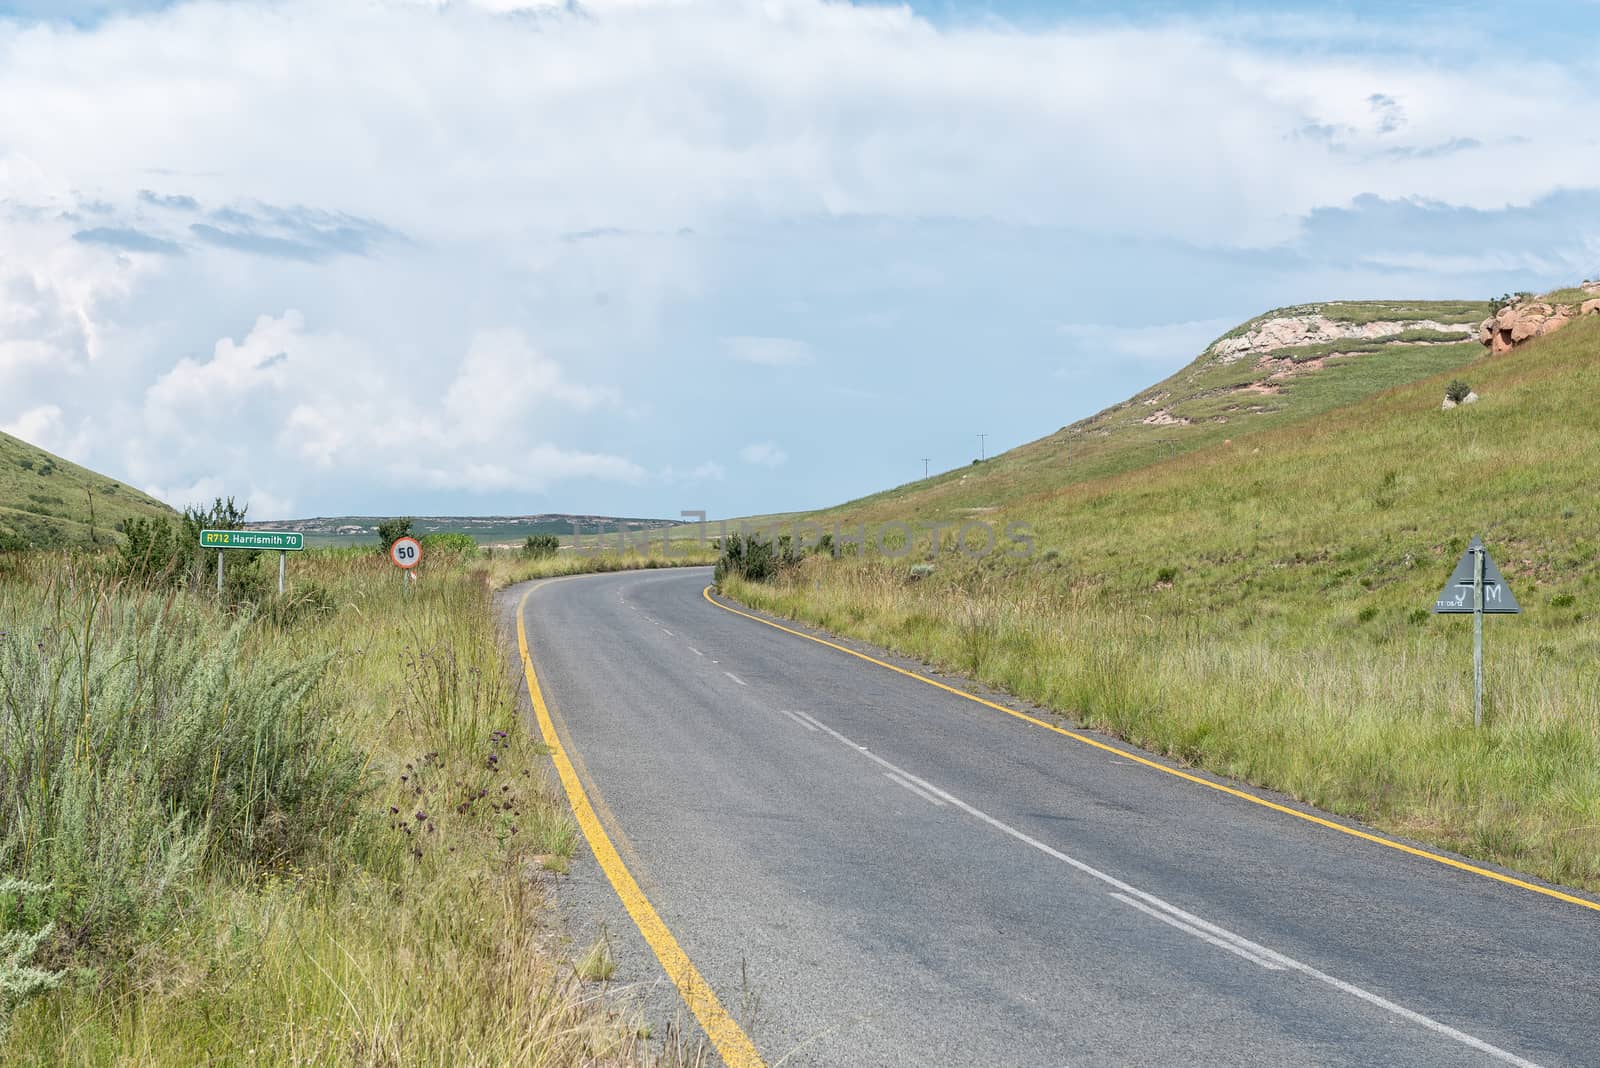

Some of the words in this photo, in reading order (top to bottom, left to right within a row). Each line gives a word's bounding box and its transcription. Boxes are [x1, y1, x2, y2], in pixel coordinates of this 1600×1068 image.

[207, 534, 230, 543] R712
[233, 535, 282, 545] Harrismith
[287, 537, 297, 545] 70
[399, 547, 414, 558] 50
